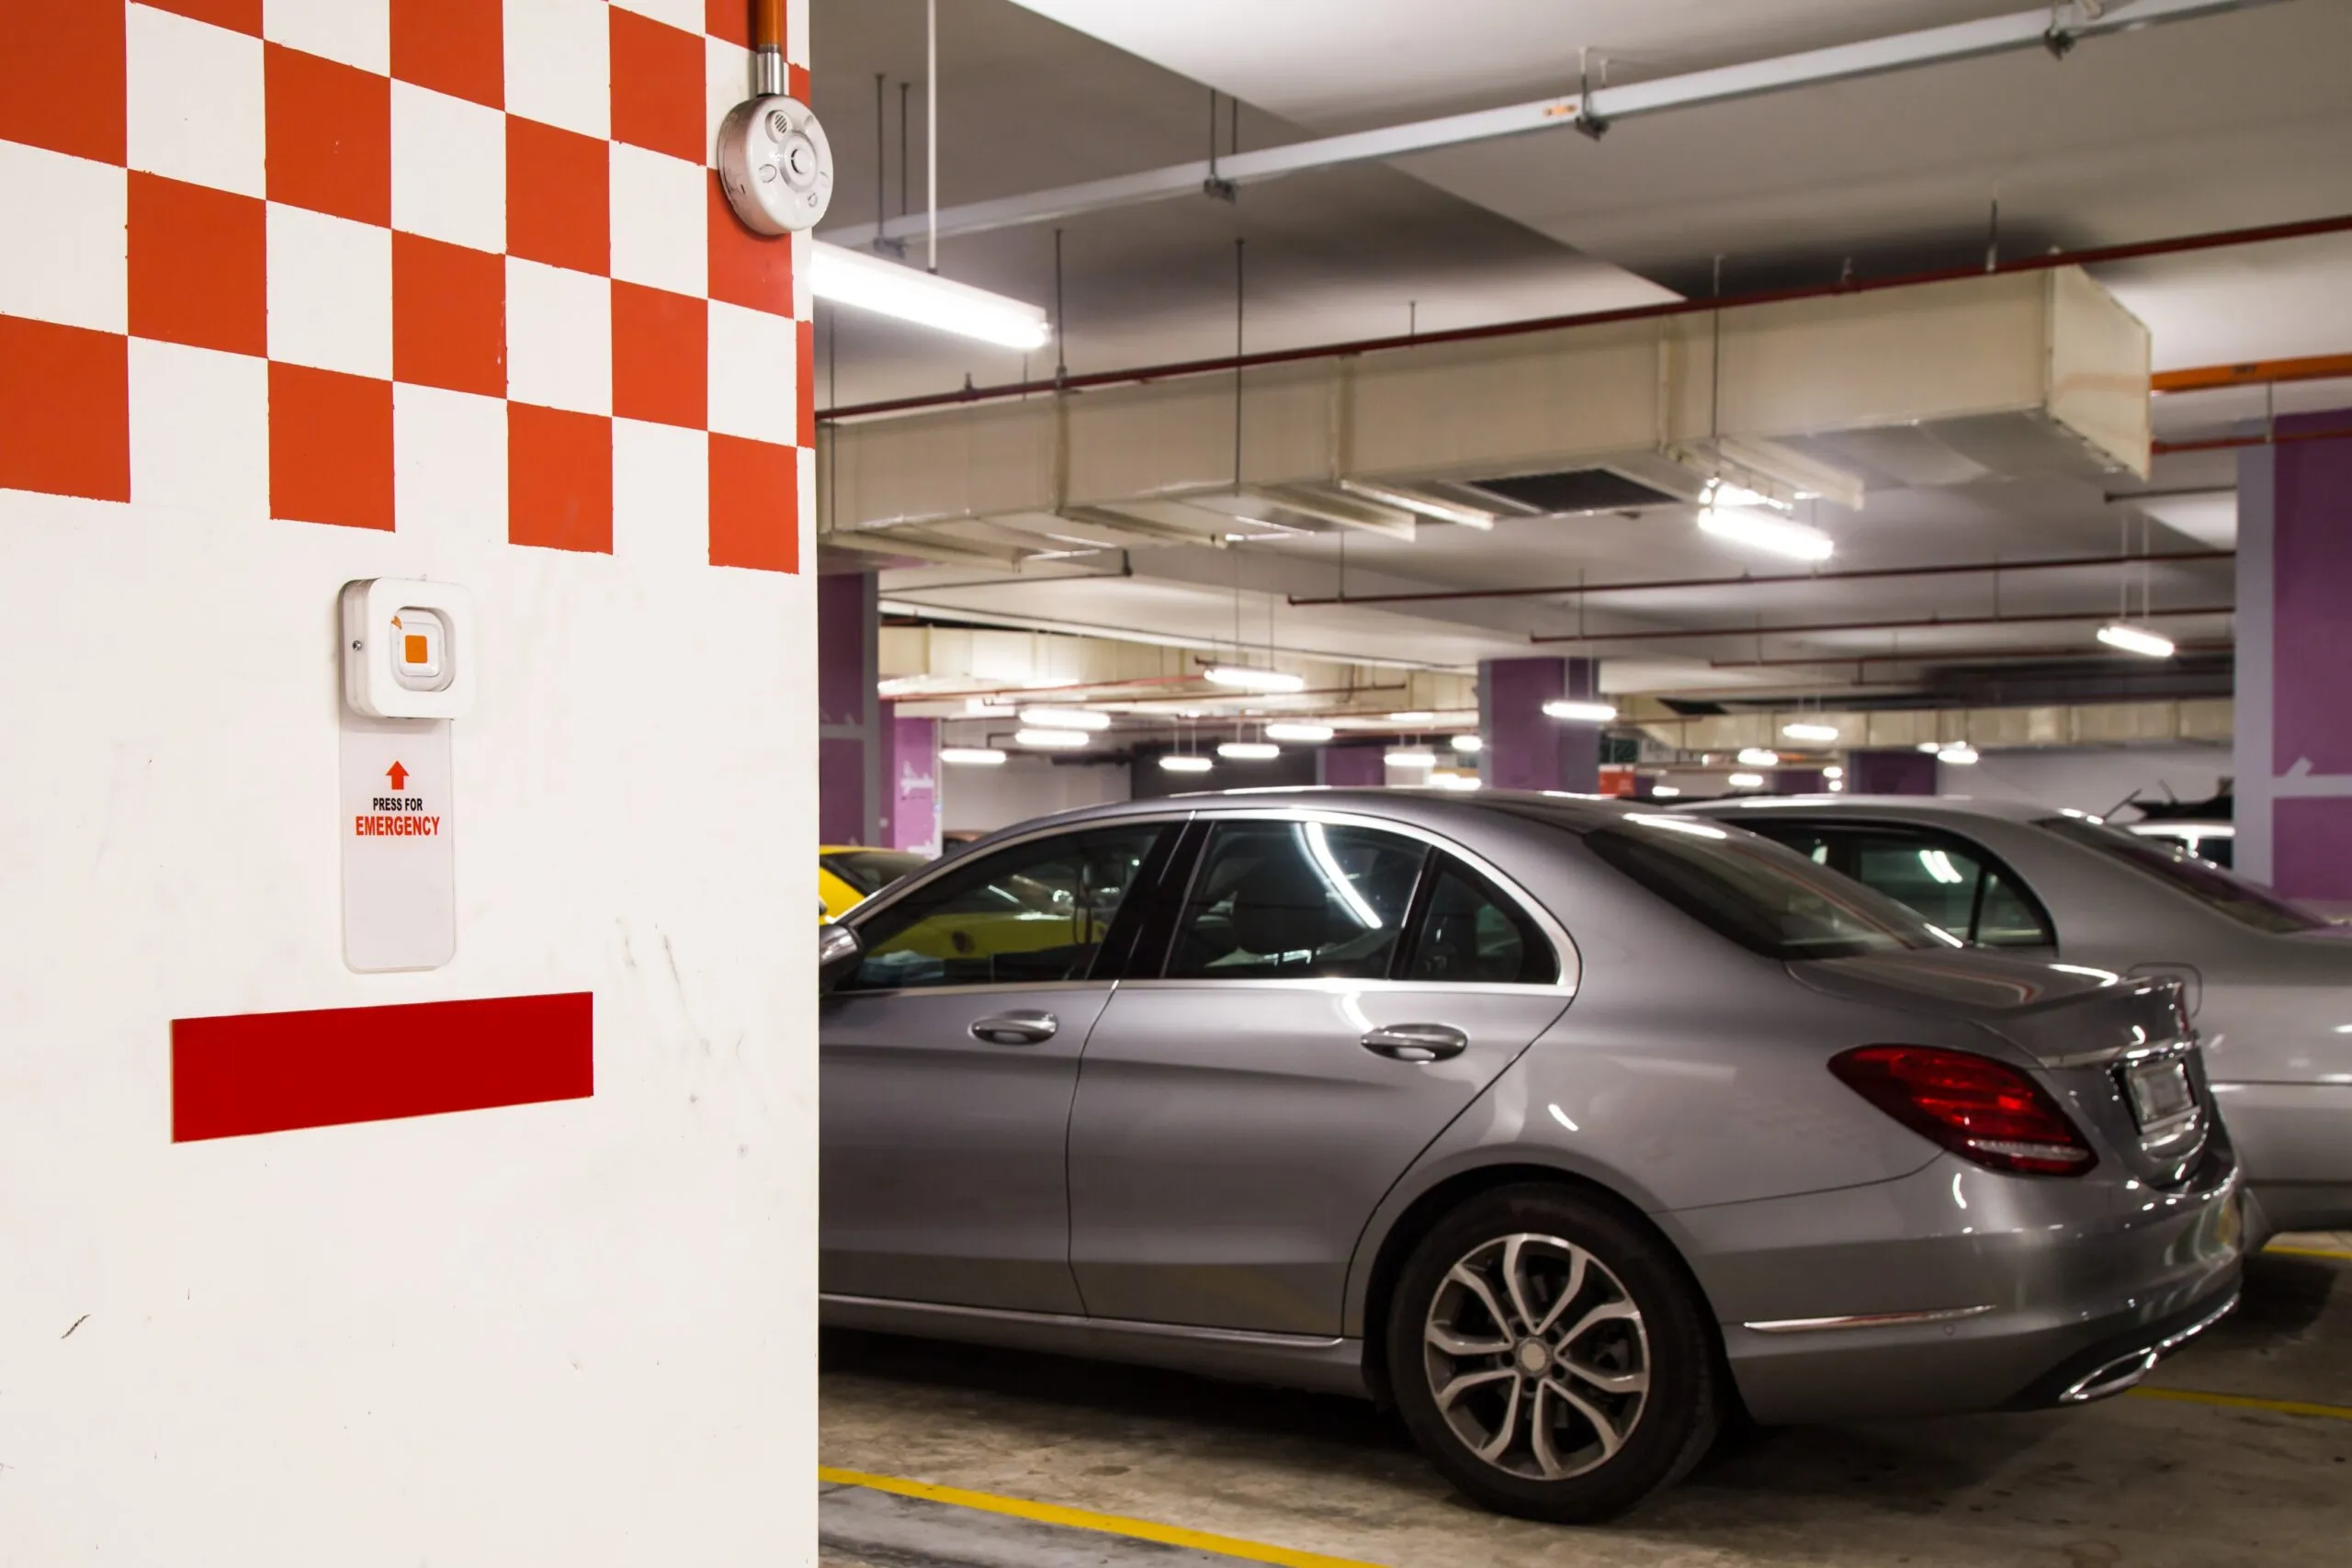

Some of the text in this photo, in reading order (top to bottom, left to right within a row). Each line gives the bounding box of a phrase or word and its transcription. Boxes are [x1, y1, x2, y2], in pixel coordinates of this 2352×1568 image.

[373, 797, 424, 811] PRESS FOR
[356, 816, 440, 836] EMERGENCY
